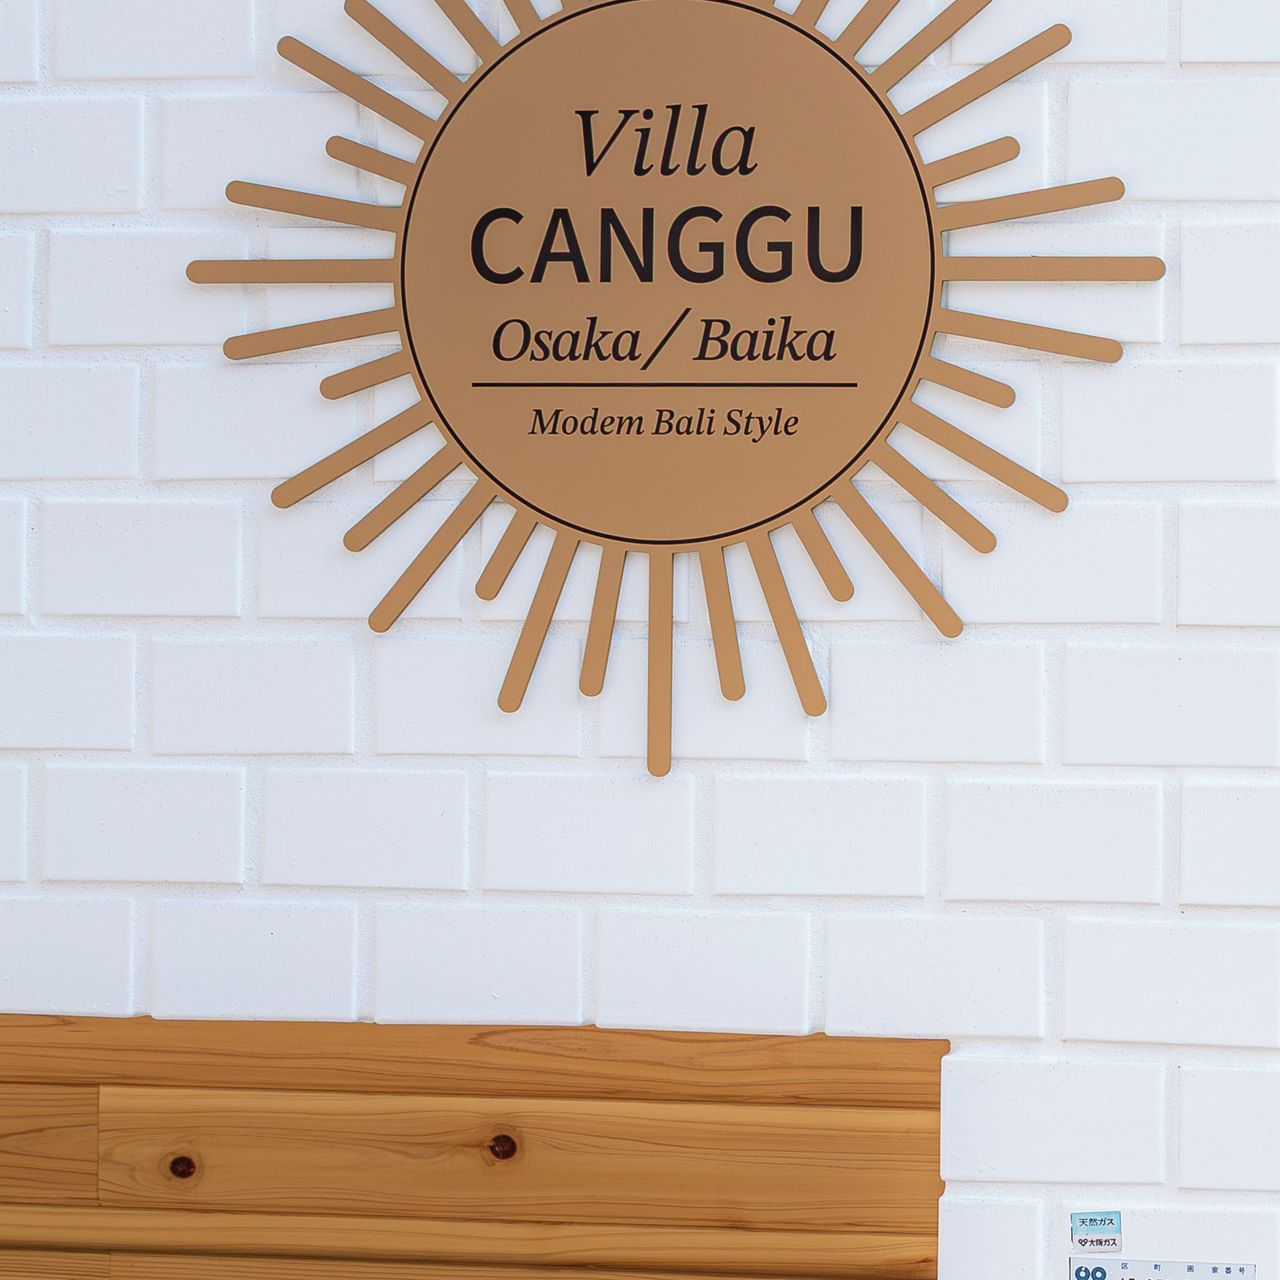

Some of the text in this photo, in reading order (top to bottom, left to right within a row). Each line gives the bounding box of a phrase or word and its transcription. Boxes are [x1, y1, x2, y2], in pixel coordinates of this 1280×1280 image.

[574, 103, 759, 177] Villa
[470, 205, 864, 285] CANGGU
[650, 407, 716, 436] Bali
[722, 407, 800, 444] Style
[1078, 1218, 1115, 1227] 天然ガス
[1088, 1238, 1118, 1247] 大阪ガス
